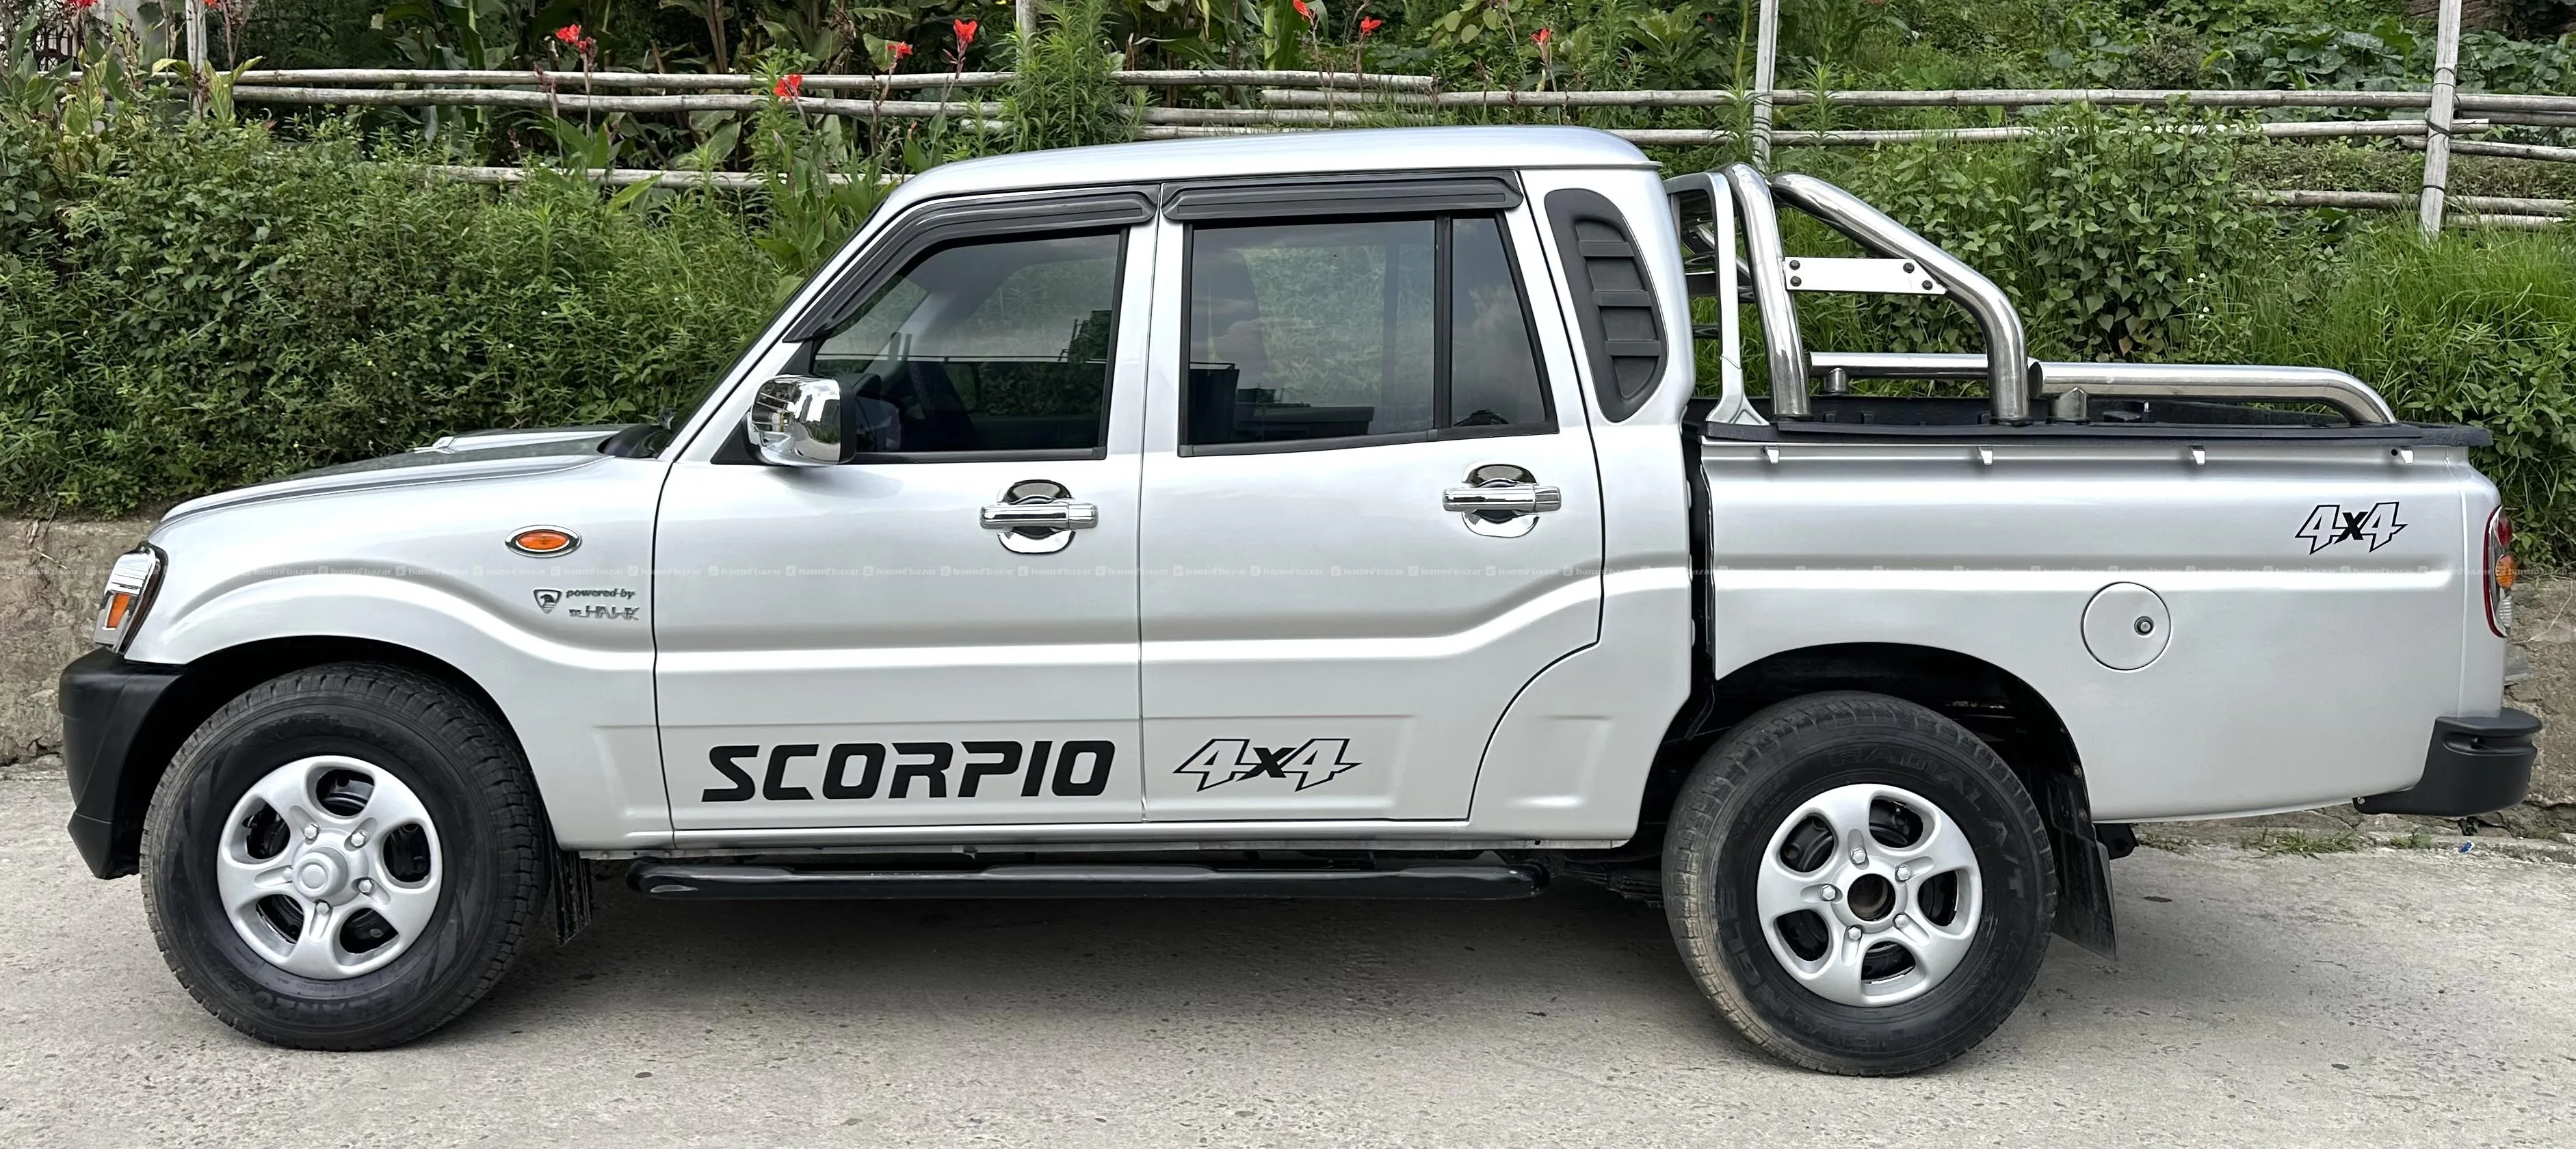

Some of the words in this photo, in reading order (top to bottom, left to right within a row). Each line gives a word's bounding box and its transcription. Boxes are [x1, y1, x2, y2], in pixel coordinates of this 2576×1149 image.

[566, 588, 618, 598] powered
[620, 588, 636, 600] by
[701, 741, 1115, 802] SCORPIO
